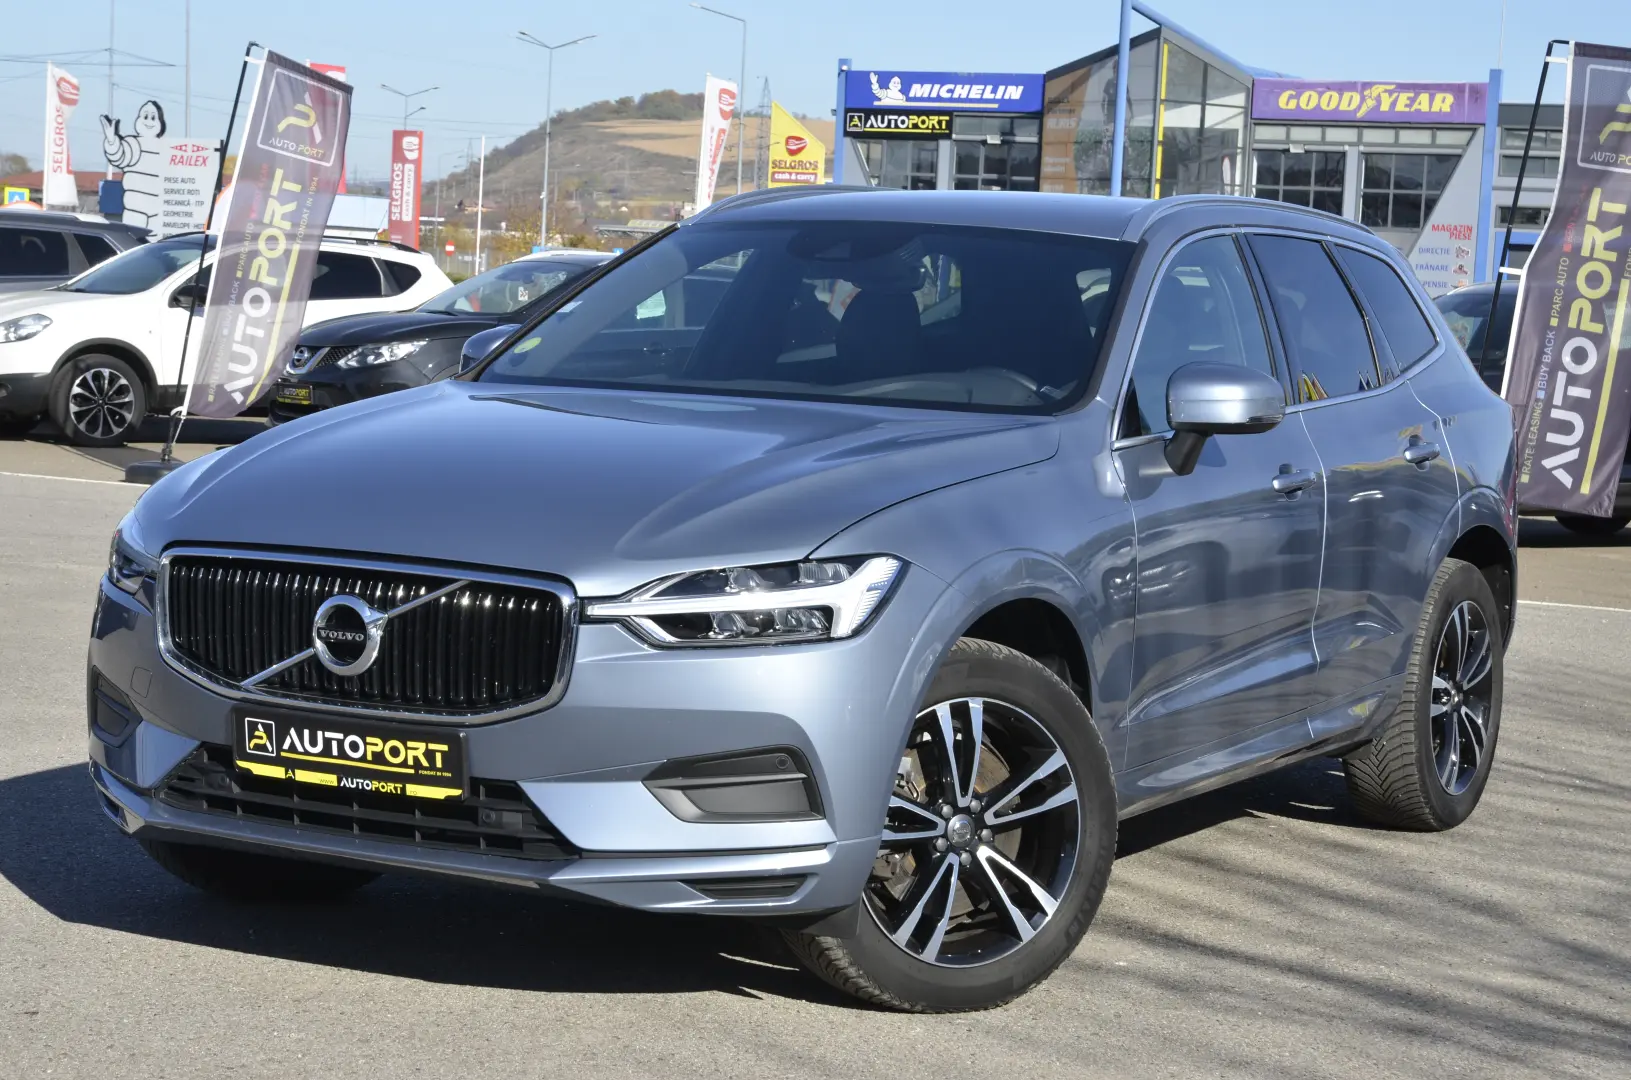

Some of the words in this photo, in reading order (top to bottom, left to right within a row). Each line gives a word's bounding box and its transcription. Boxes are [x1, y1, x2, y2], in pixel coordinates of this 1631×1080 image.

[908, 83, 1024, 100] MICHELIN
[865, 114, 950, 129] AUTOPORT
[53, 105, 65, 174] SELGROS
[268, 136, 296, 150] AUTO
[297, 144, 325, 157] PORT
[169, 154, 209, 167] RAILEX
[771, 159, 819, 171] SELGROS
[1589, 151, 1616, 163] AUTO
[308, 177, 319, 195] 1994
[391, 162, 403, 221] SELGROS
[306, 197, 313, 207] IN
[162, 221, 191, 230] ANVELOPE
[163, 210, 194, 218] GEOMETRIE
[296, 209, 310, 244] FONDAT
[1431, 224, 1473, 233] MAGAZIN
[1449, 231, 1472, 240] PIESE
[237, 246, 249, 271] PARC
[243, 222, 255, 246] AUTO
[1556, 257, 1569, 287] AUTO
[223, 168, 302, 405] AUTOPORT
[228, 281, 240, 307] BACK
[1551, 288, 1564, 317] PARC
[1541, 187, 1628, 490] AUTOPORT
[1542, 329, 1556, 363] BACK
[1537, 364, 1550, 390] BUY
[1527, 402, 1543, 446] LEASING
[1521, 447, 1535, 474] RATE
[318, 628, 365, 642] VOLVO
[282, 727, 449, 768] AUTOPORT
[340, 777, 403, 794] AUTOPORT
